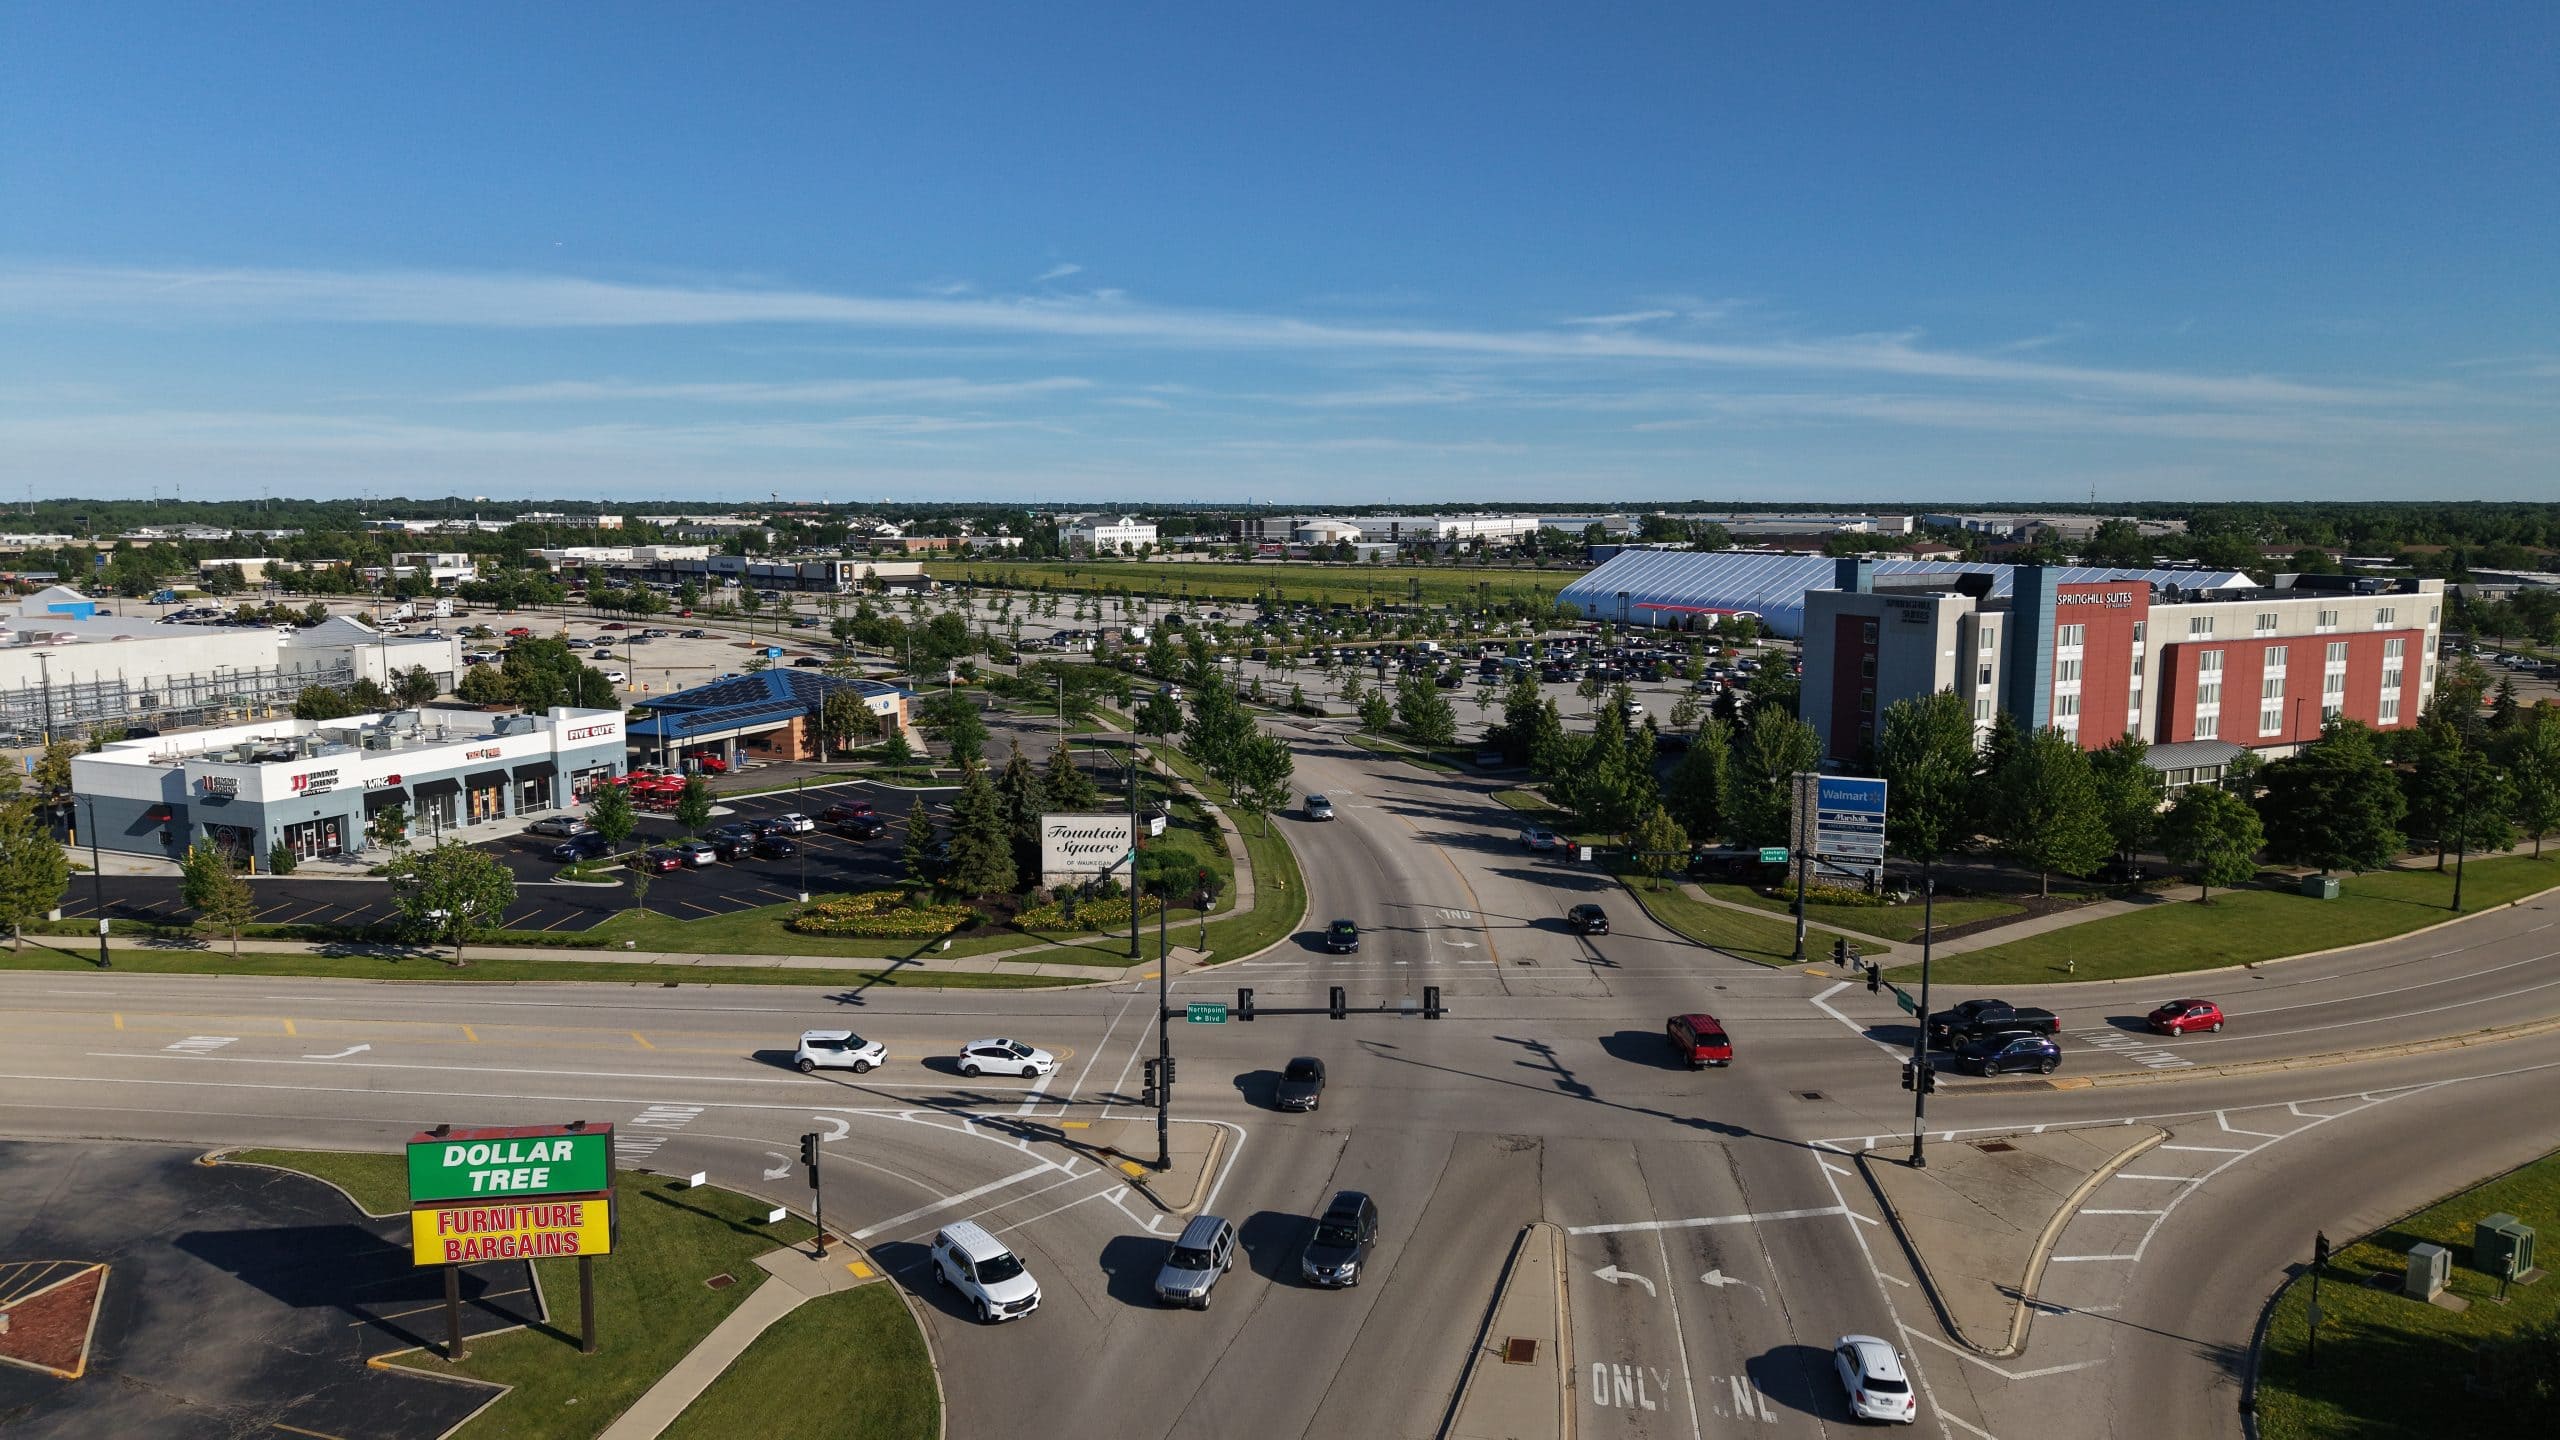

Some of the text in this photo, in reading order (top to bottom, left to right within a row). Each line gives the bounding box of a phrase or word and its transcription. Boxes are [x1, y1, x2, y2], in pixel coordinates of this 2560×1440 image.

[2057, 591, 2133, 606] SPRINGHILL SUITES
[569, 725, 616, 740] FIVE GUYS
[291, 773, 307, 792] JJ
[308, 769, 339, 781] JIMMY
[1822, 789, 1868, 802] Walmart
[1833, 813, 1869, 823] Marshalls
[1047, 825, 1127, 839] Fountain
[1056, 840, 1119, 857] Square
[1188, 1006, 1225, 1014] Northpoint
[442, 1140, 574, 1167] DOLLAR
[468, 1167, 550, 1192] TREE
[437, 1203, 584, 1236] FURNITURE
[444, 1231, 580, 1262] BARGAINS
[1592, 1362, 1673, 1412] ONLY
